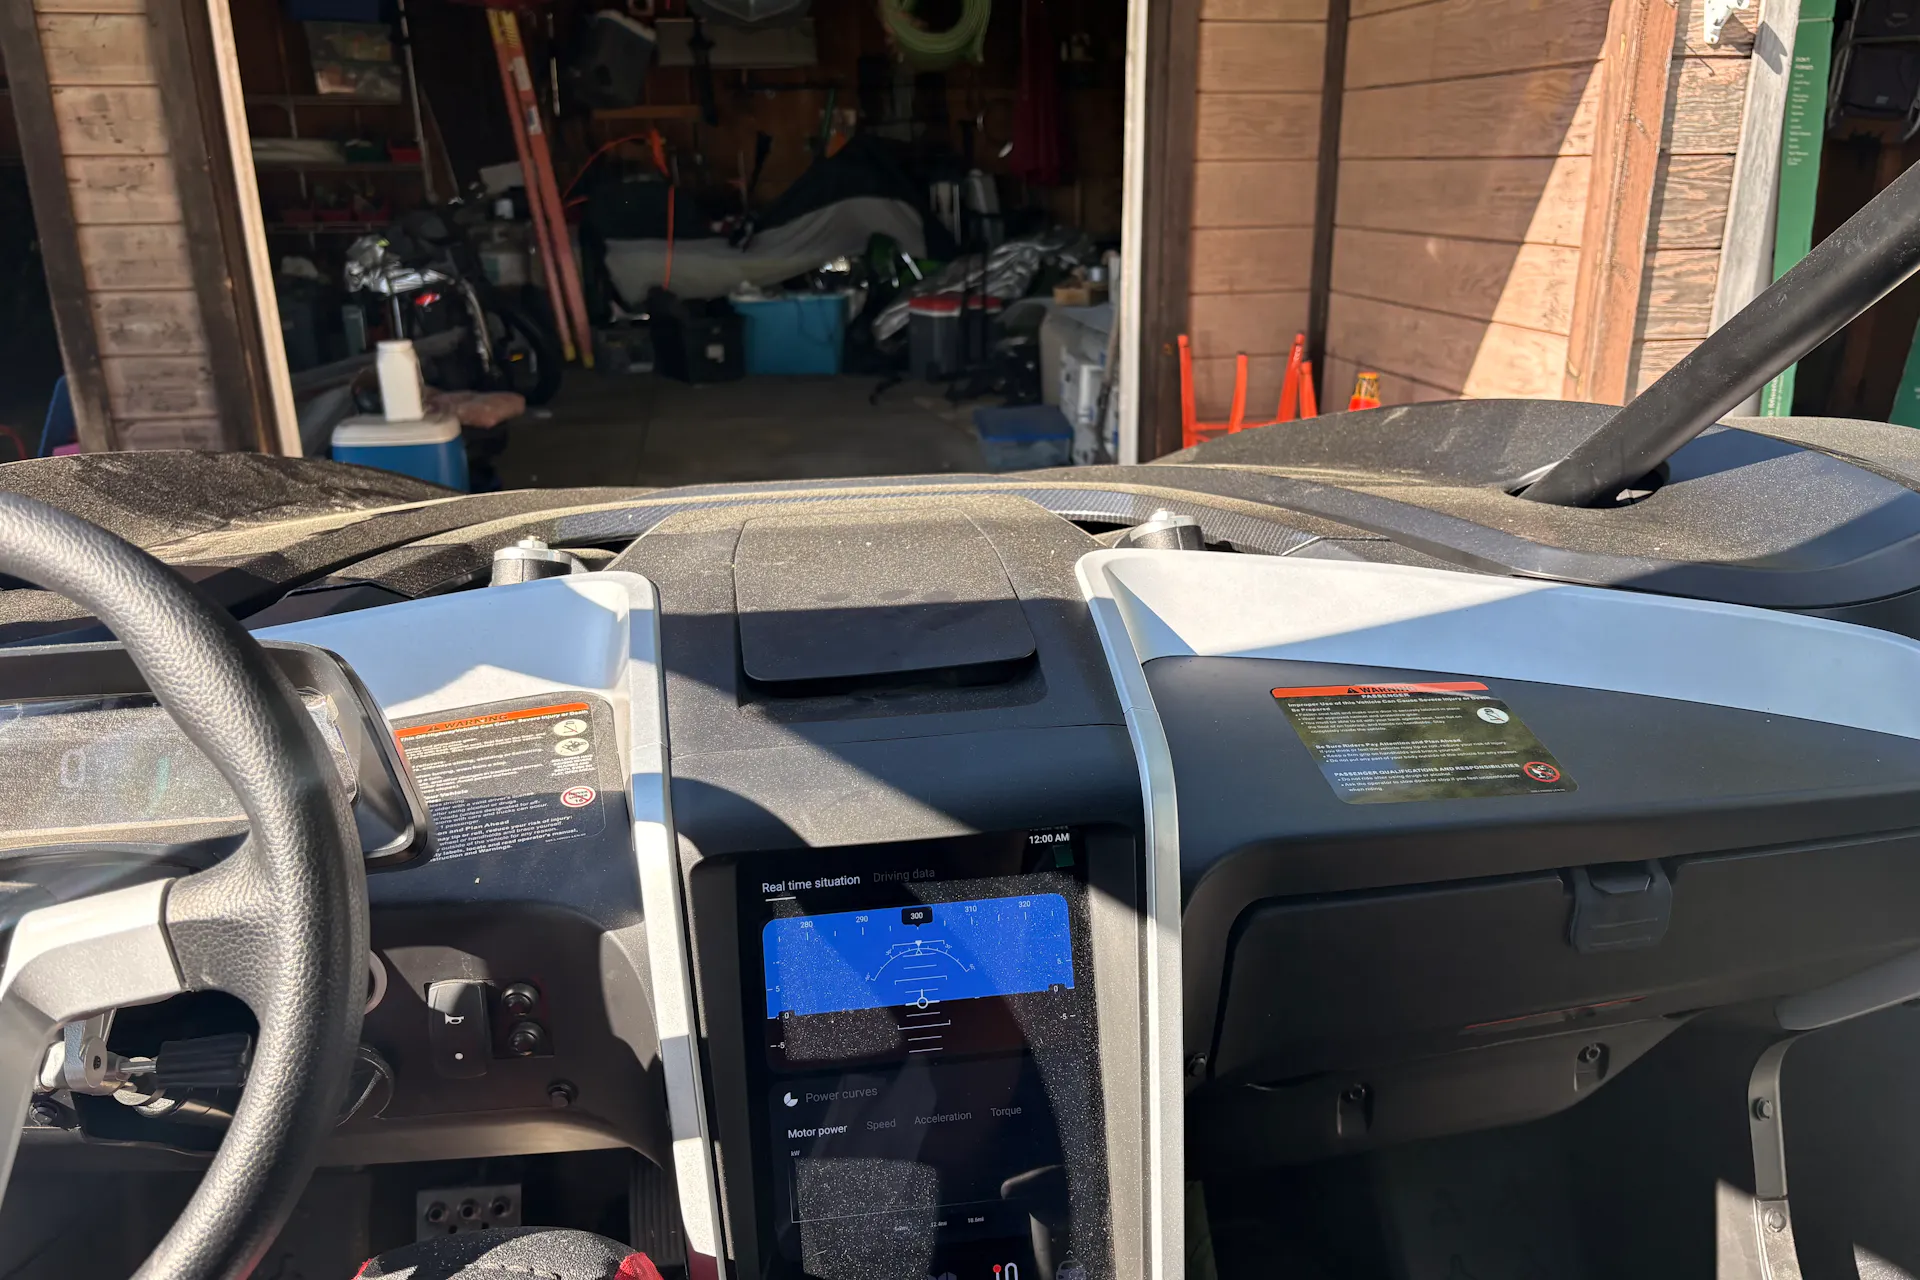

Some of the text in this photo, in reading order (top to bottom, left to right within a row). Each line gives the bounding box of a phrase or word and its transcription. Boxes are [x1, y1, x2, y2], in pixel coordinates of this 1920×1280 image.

[444, 714, 508, 729] WARNING
[484, 804, 519, 813] designated
[1029, 833, 1070, 844] 12:00 AM
[430, 854, 463, 862] struction
[874, 869, 935, 882] Driving data
[762, 875, 860, 893] Real time situation
[806, 1088, 878, 1102] Power curves
[915, 1112, 972, 1124] Acceleration
[990, 1107, 1021, 1117] Torque
[866, 1118, 896, 1131] Speed
[788, 1125, 848, 1138] Motor power
